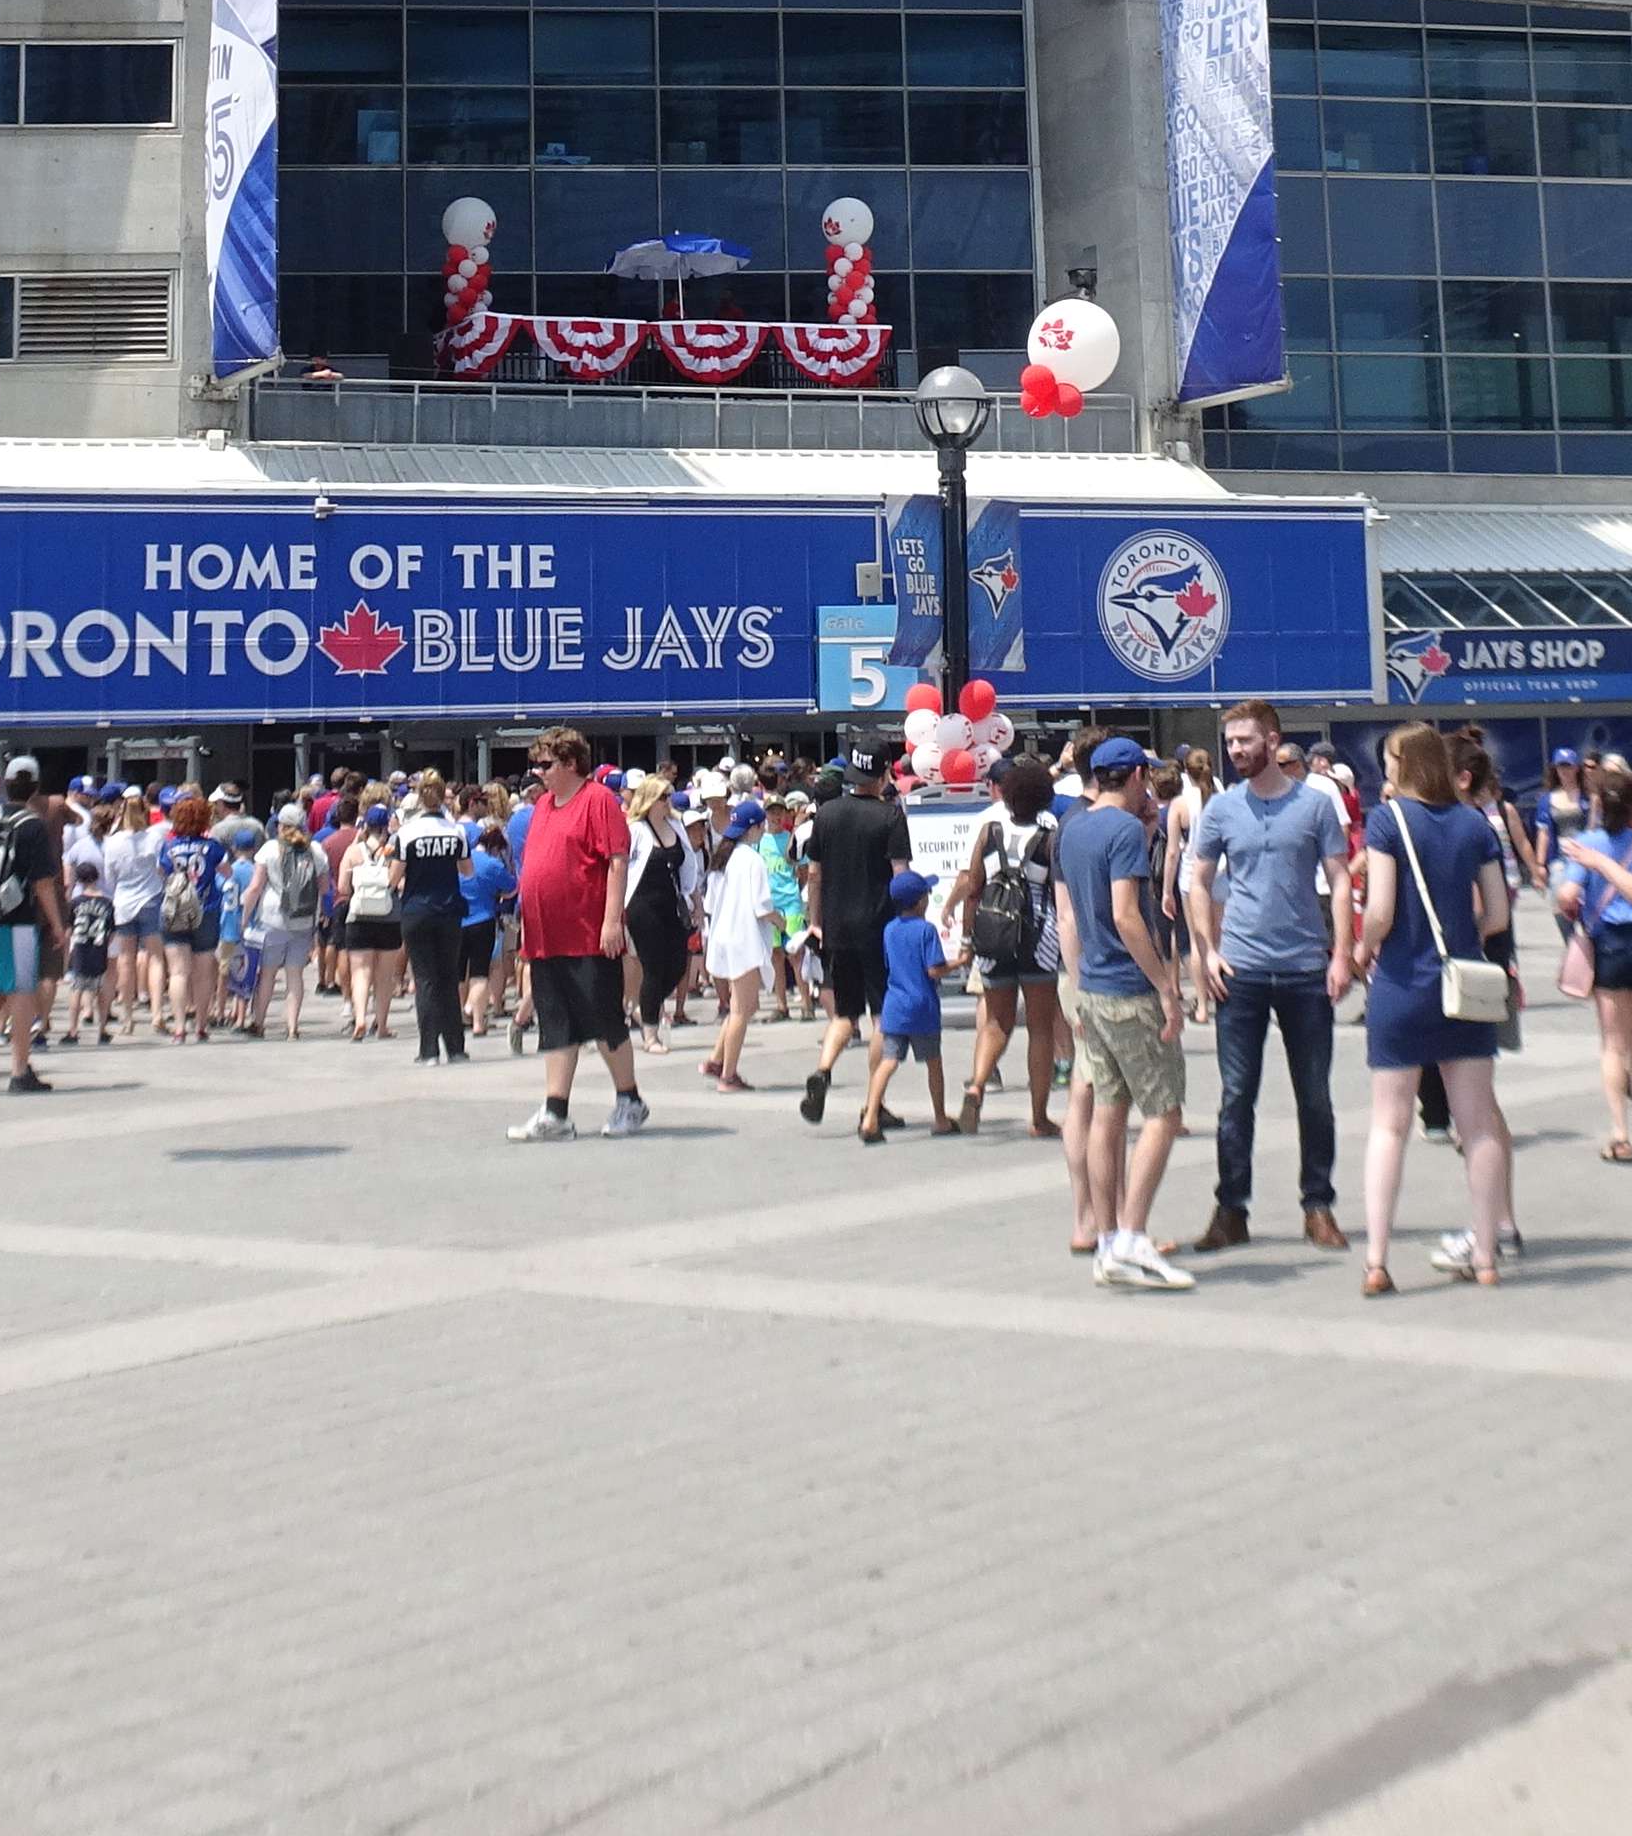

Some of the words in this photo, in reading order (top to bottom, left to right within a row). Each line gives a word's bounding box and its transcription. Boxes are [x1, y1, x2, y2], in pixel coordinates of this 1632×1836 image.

[1175, 104, 1198, 134] GO
[1199, 172, 1236, 204] BLUE
[1201, 196, 1237, 229] JAYS
[144, 543, 318, 591] HOME
[349, 544, 424, 591] OF
[451, 543, 557, 590] THE
[907, 556, 926, 573] GO
[1110, 541, 1192, 590] TORONTO
[905, 573, 936, 595] BLUE
[911, 596, 941, 617] JAYS
[825, 614, 866, 631] Gate
[413, 606, 585, 673] BLUE
[602, 605, 776, 670] JAYS
[1111, 619, 1162, 671] BLUE
[1172, 623, 1218, 671] JAYS
[1457, 640, 1526, 670] JAYS
[1529, 639, 1606, 668] SHOP
[849, 645, 888, 708] 5
[1463, 679, 1522, 692] OFFICIAL
[1527, 679, 1561, 691] TEAM
[415, 837, 458, 858] STAFF
[918, 841, 959, 853] SECURITY
